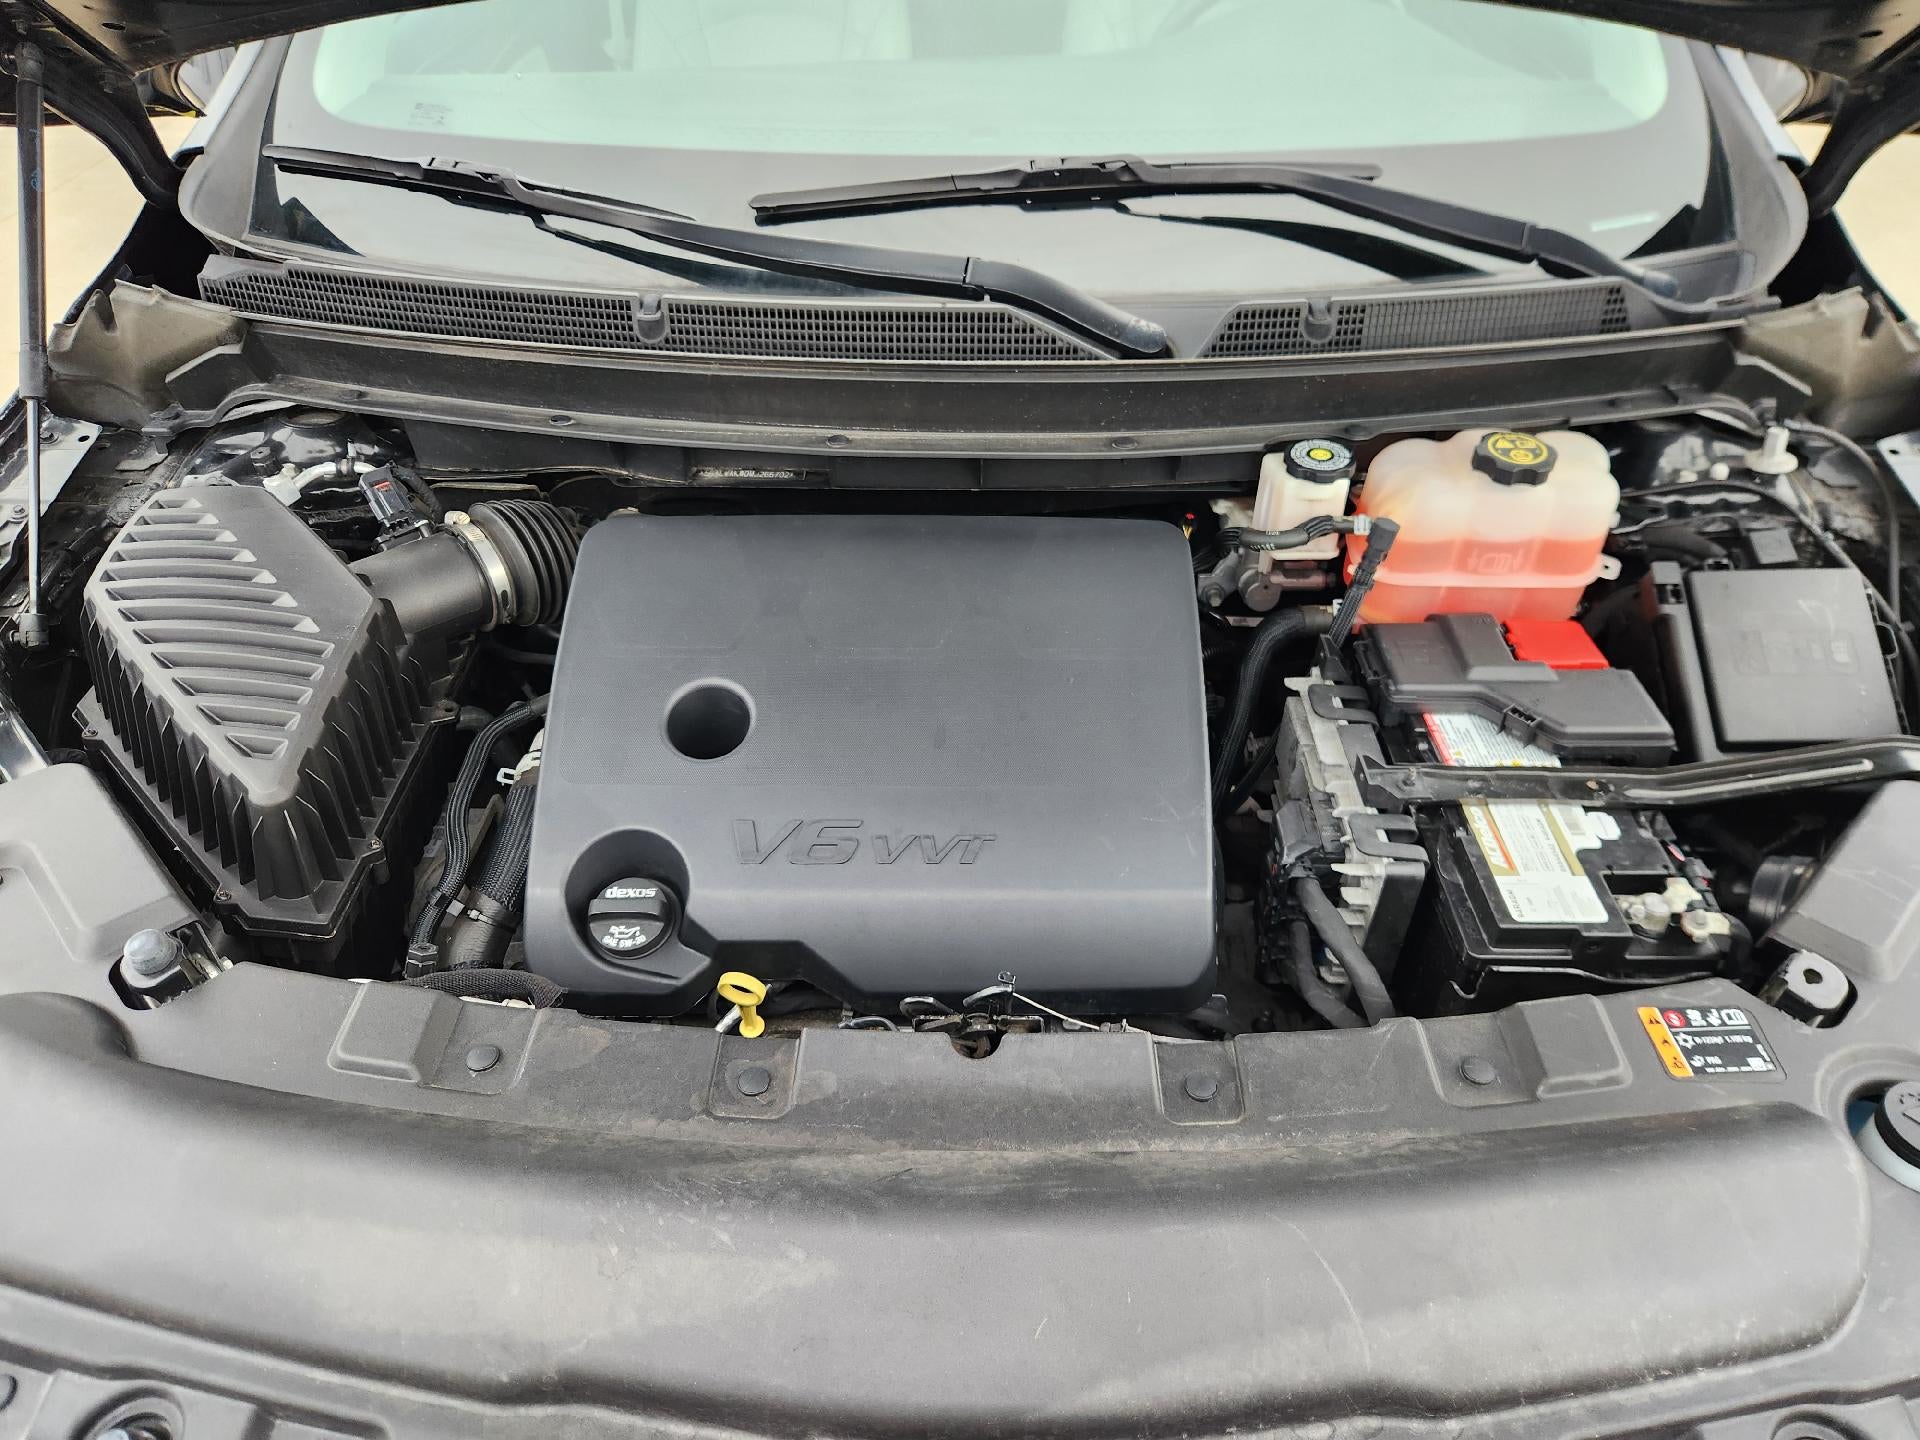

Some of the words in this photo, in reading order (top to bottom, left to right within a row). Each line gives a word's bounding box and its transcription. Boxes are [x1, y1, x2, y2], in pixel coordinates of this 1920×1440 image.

[732, 819, 864, 866] V6
[871, 834, 998, 865] VVT
[604, 886, 658, 899] dexos
[601, 935, 619, 947] SAE
